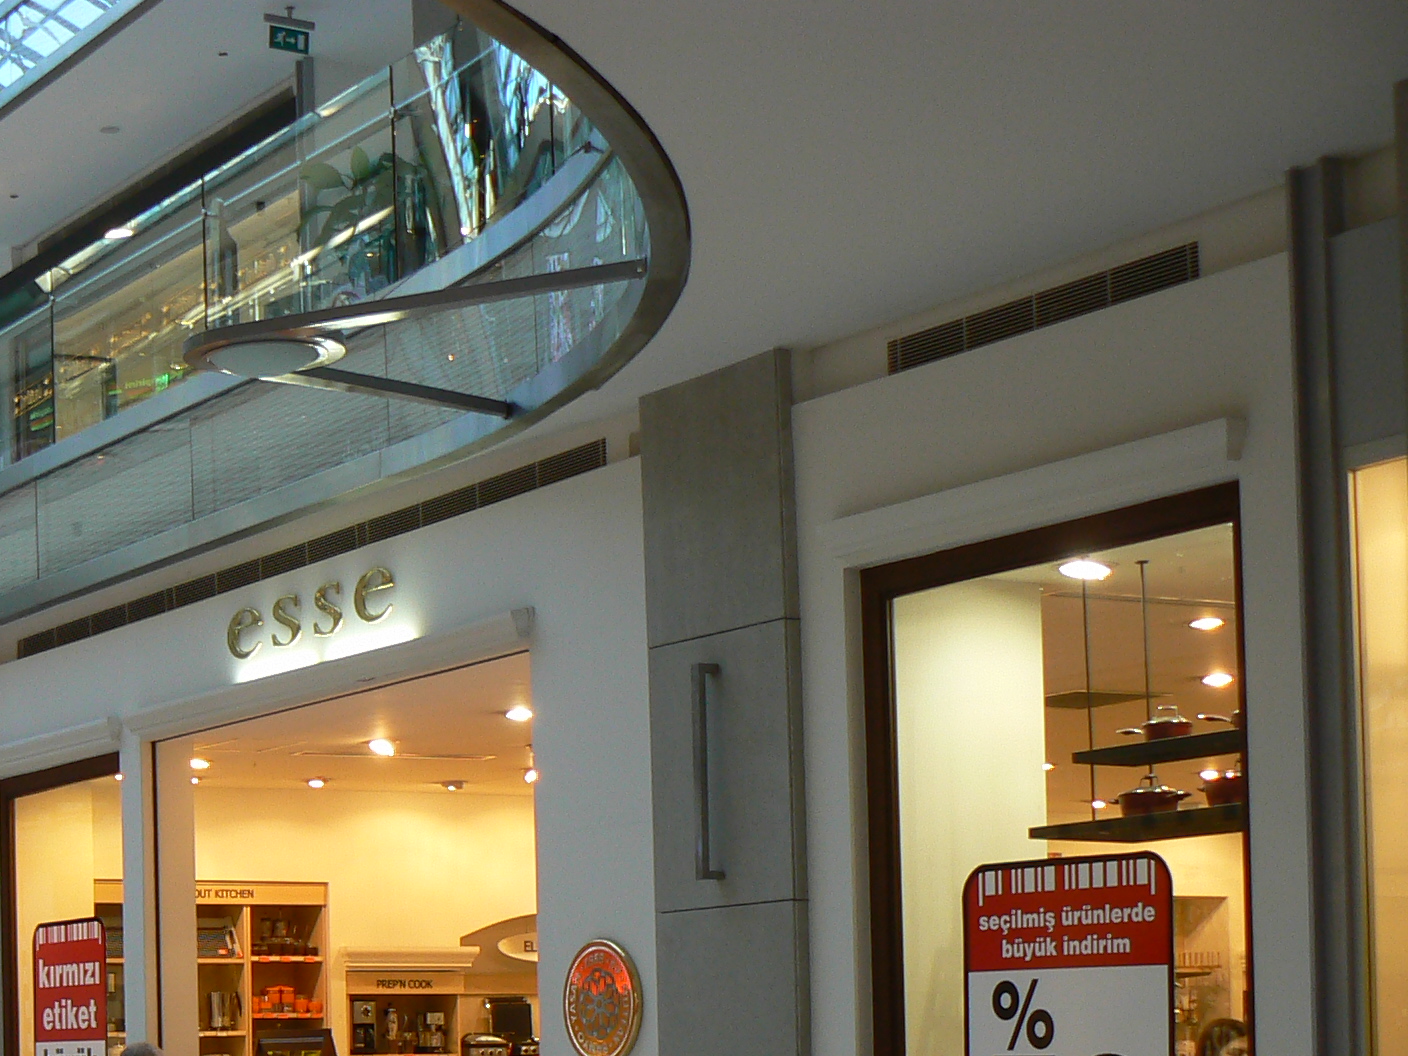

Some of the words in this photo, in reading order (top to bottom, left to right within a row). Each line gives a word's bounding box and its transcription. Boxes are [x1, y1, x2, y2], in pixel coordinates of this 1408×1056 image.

[227, 567, 395, 660] esse
[215, 888, 255, 900] KITCHEN
[979, 907, 1055, 934] seçilmiş
[1061, 902, 1156, 927] ürünlerde
[1002, 937, 1058, 962] büyük
[1063, 934, 1131, 957] indirim
[38, 959, 101, 988] kırmızı
[407, 979, 434, 990] COOK
[42, 998, 98, 1031] etiket
[992, 978, 1054, 1051] %
